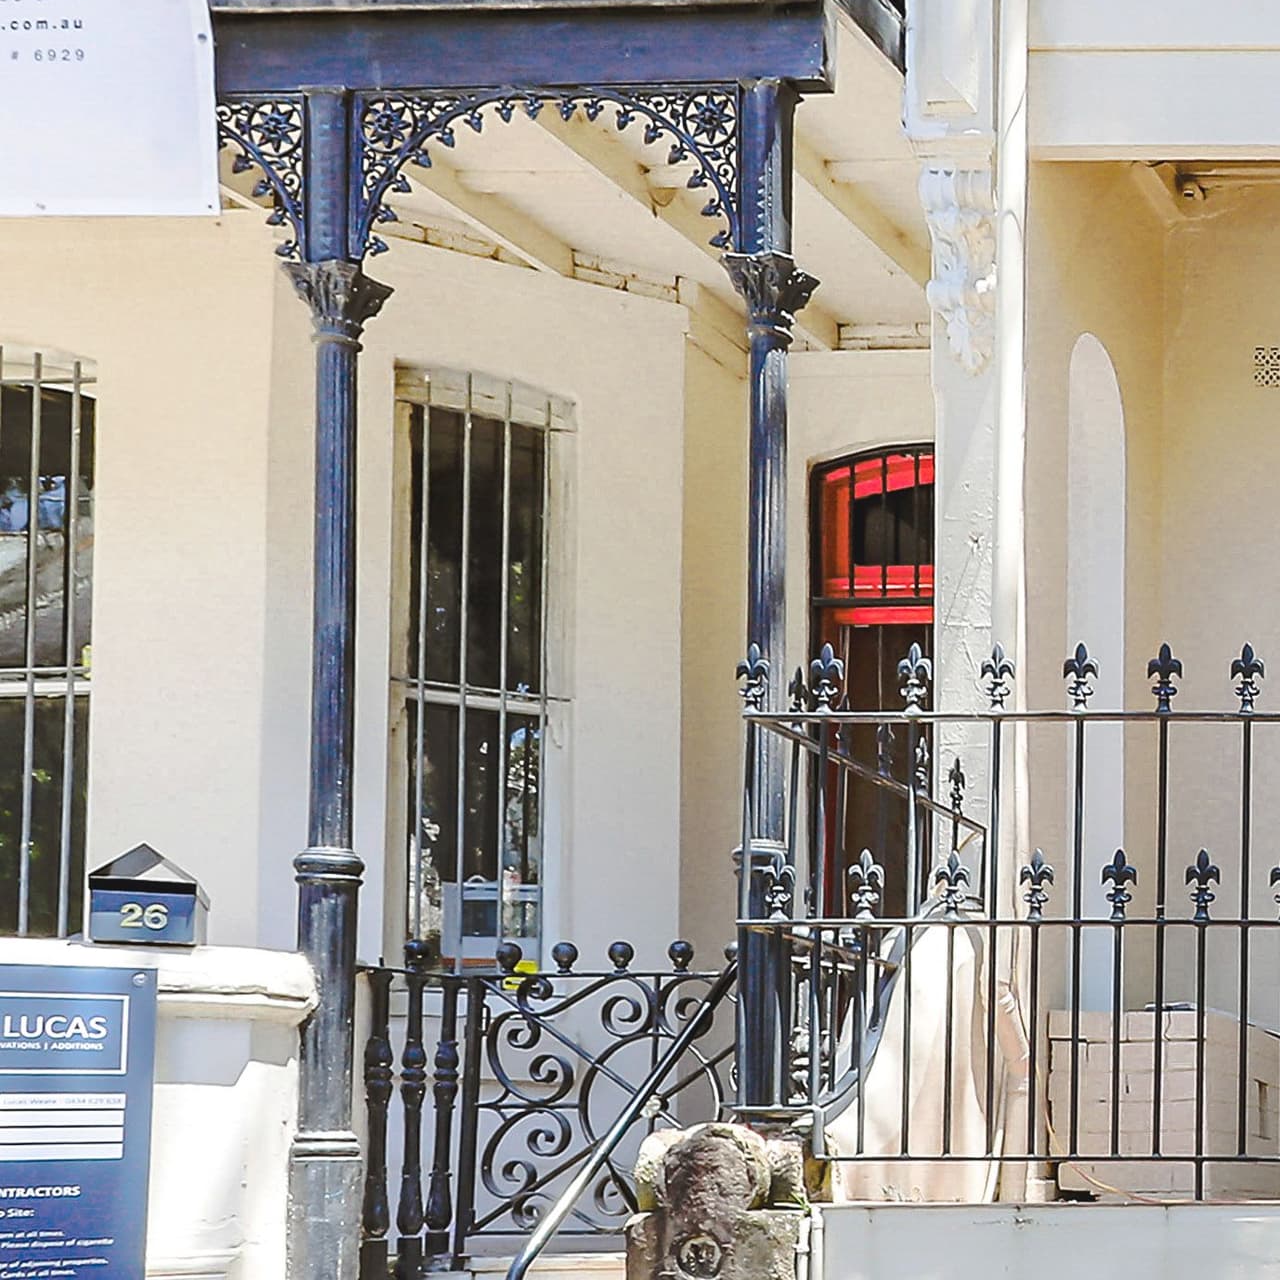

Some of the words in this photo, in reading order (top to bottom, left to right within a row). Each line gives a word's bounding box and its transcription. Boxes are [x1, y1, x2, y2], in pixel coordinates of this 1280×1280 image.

[34, 49, 84, 61] 6929
[120, 903, 168, 929] 26
[3, 1015, 108, 1039] LUCAS
[50, 1042, 104, 1050] ADDITIONS
[7, 1208, 35, 1218] Site:
